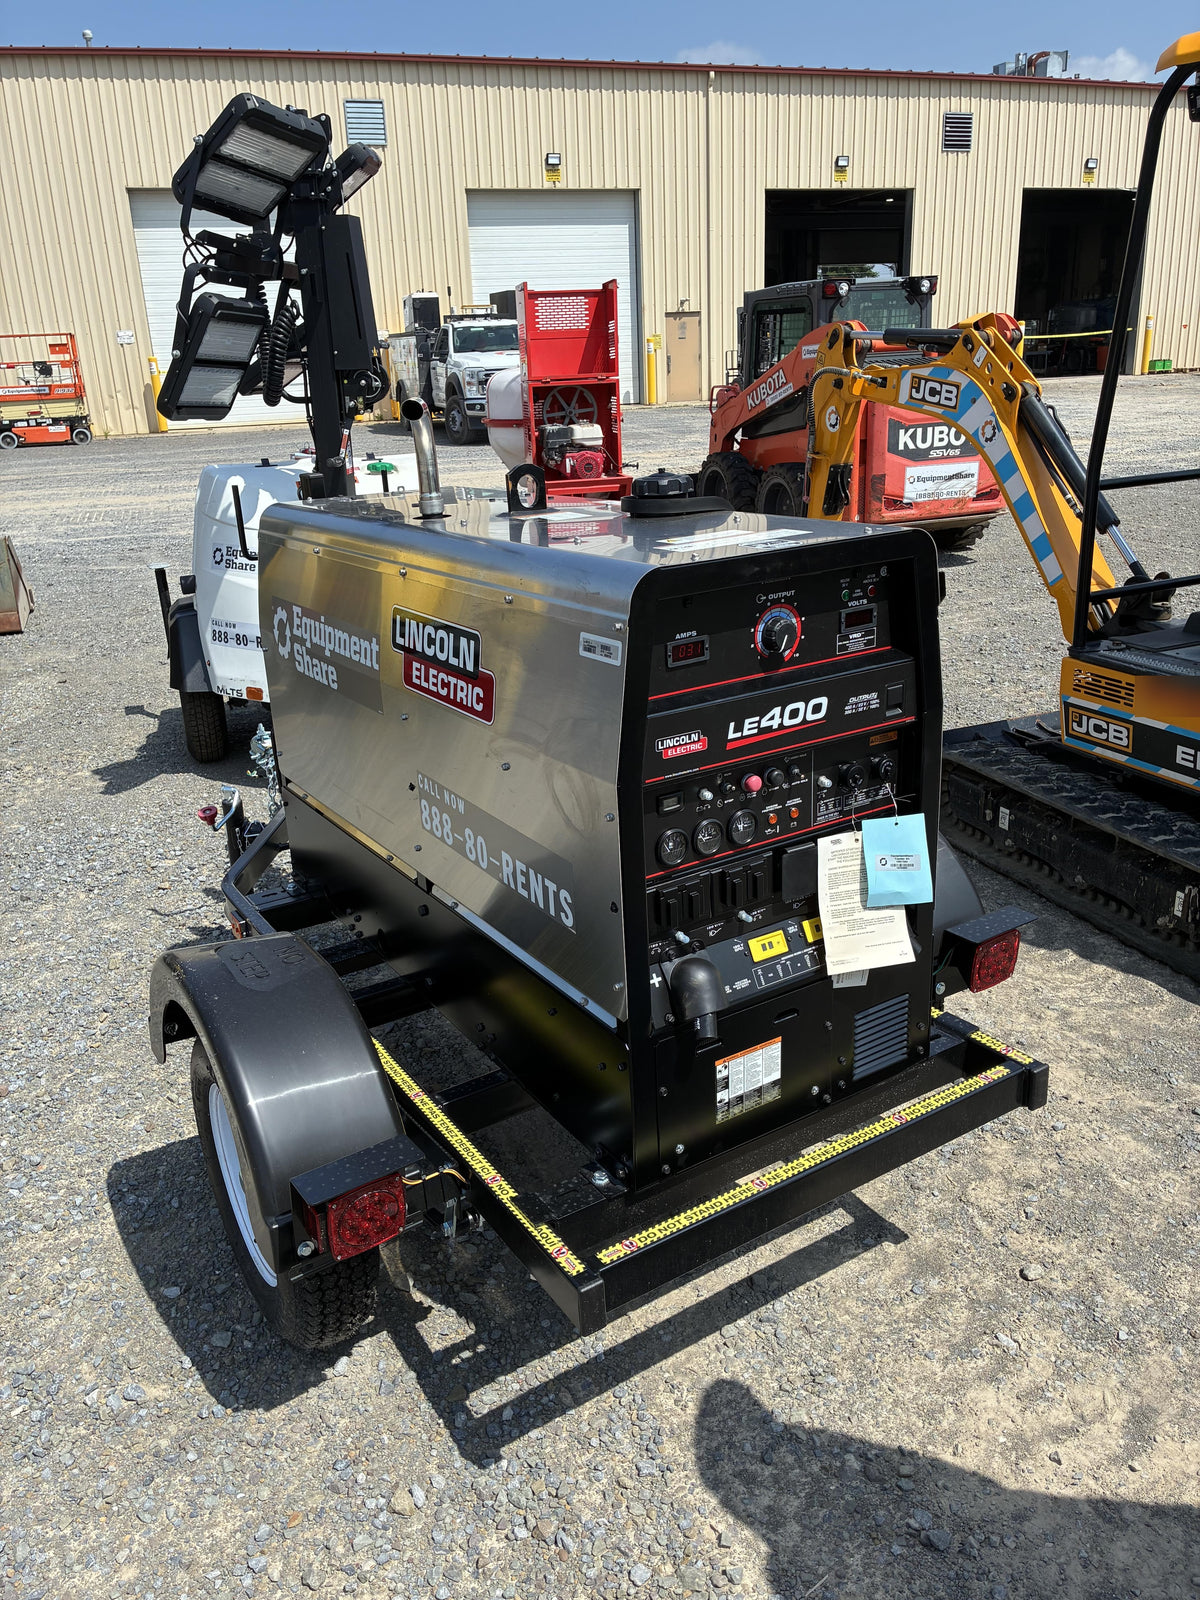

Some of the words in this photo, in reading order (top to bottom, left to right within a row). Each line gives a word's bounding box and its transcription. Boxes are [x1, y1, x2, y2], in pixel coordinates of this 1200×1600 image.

[746, 369, 787, 411] KUBOTA
[911, 379, 958, 407] JCB
[898, 425, 966, 451] KUBO
[928, 448, 961, 458] SSV65
[916, 472, 975, 484] EquipmentShare
[225, 558, 256, 572] Share
[768, 590, 796, 600] OUTPUT
[847, 598, 868, 608] VOLTS
[211, 619, 224, 628] CALL
[225, 621, 237, 630] NOW
[292, 605, 380, 671] Equipment
[675, 630, 697, 640] AMPS
[395, 614, 475, 673] LINCOLN
[293, 643, 338, 691] Share
[216, 685, 243, 698] MLTS
[412, 661, 484, 712] ELECTRIC
[727, 696, 829, 740] LE400
[658, 732, 699, 750] LINCOLN
[667, 742, 703, 756] ELECTRIC
[1072, 714, 1129, 747] JCB
[1175, 744, 1200, 771] E
[418, 773, 441, 800] CALL
[444, 789, 465, 815] NOW
[420, 798, 574, 928] 888-80-RENTS
[383, 1059, 402, 1078] STAND
[402, 1077, 417, 1093] HERE
[419, 1098, 430, 1108] NE
[428, 1106, 441, 1120] PAS
[439, 1118, 458, 1140] TENEZ
[455, 1138, 481, 1167] DEBOUT
[480, 1165, 492, 1176] ICI
[496, 1183, 510, 1196] NO
[535, 1226, 557, 1248] AQUI
[637, 1230, 657, 1244] DO
[658, 1219, 683, 1235] NOT
[685, 1200, 724, 1222] STAND
[724, 1185, 754, 1204] HERE
[766, 1171, 783, 1183] NE
[783, 1161, 805, 1175] PAS
[806, 1144, 838, 1163] TENEZ
[837, 1126, 879, 1150] DEBOUT
[879, 1118, 894, 1131] ICI
[906, 1105, 924, 1118] NO
[924, 1099, 937, 1111] SE
[935, 1088, 958, 1104] PARE
[958, 1079, 980, 1094] AQUI
